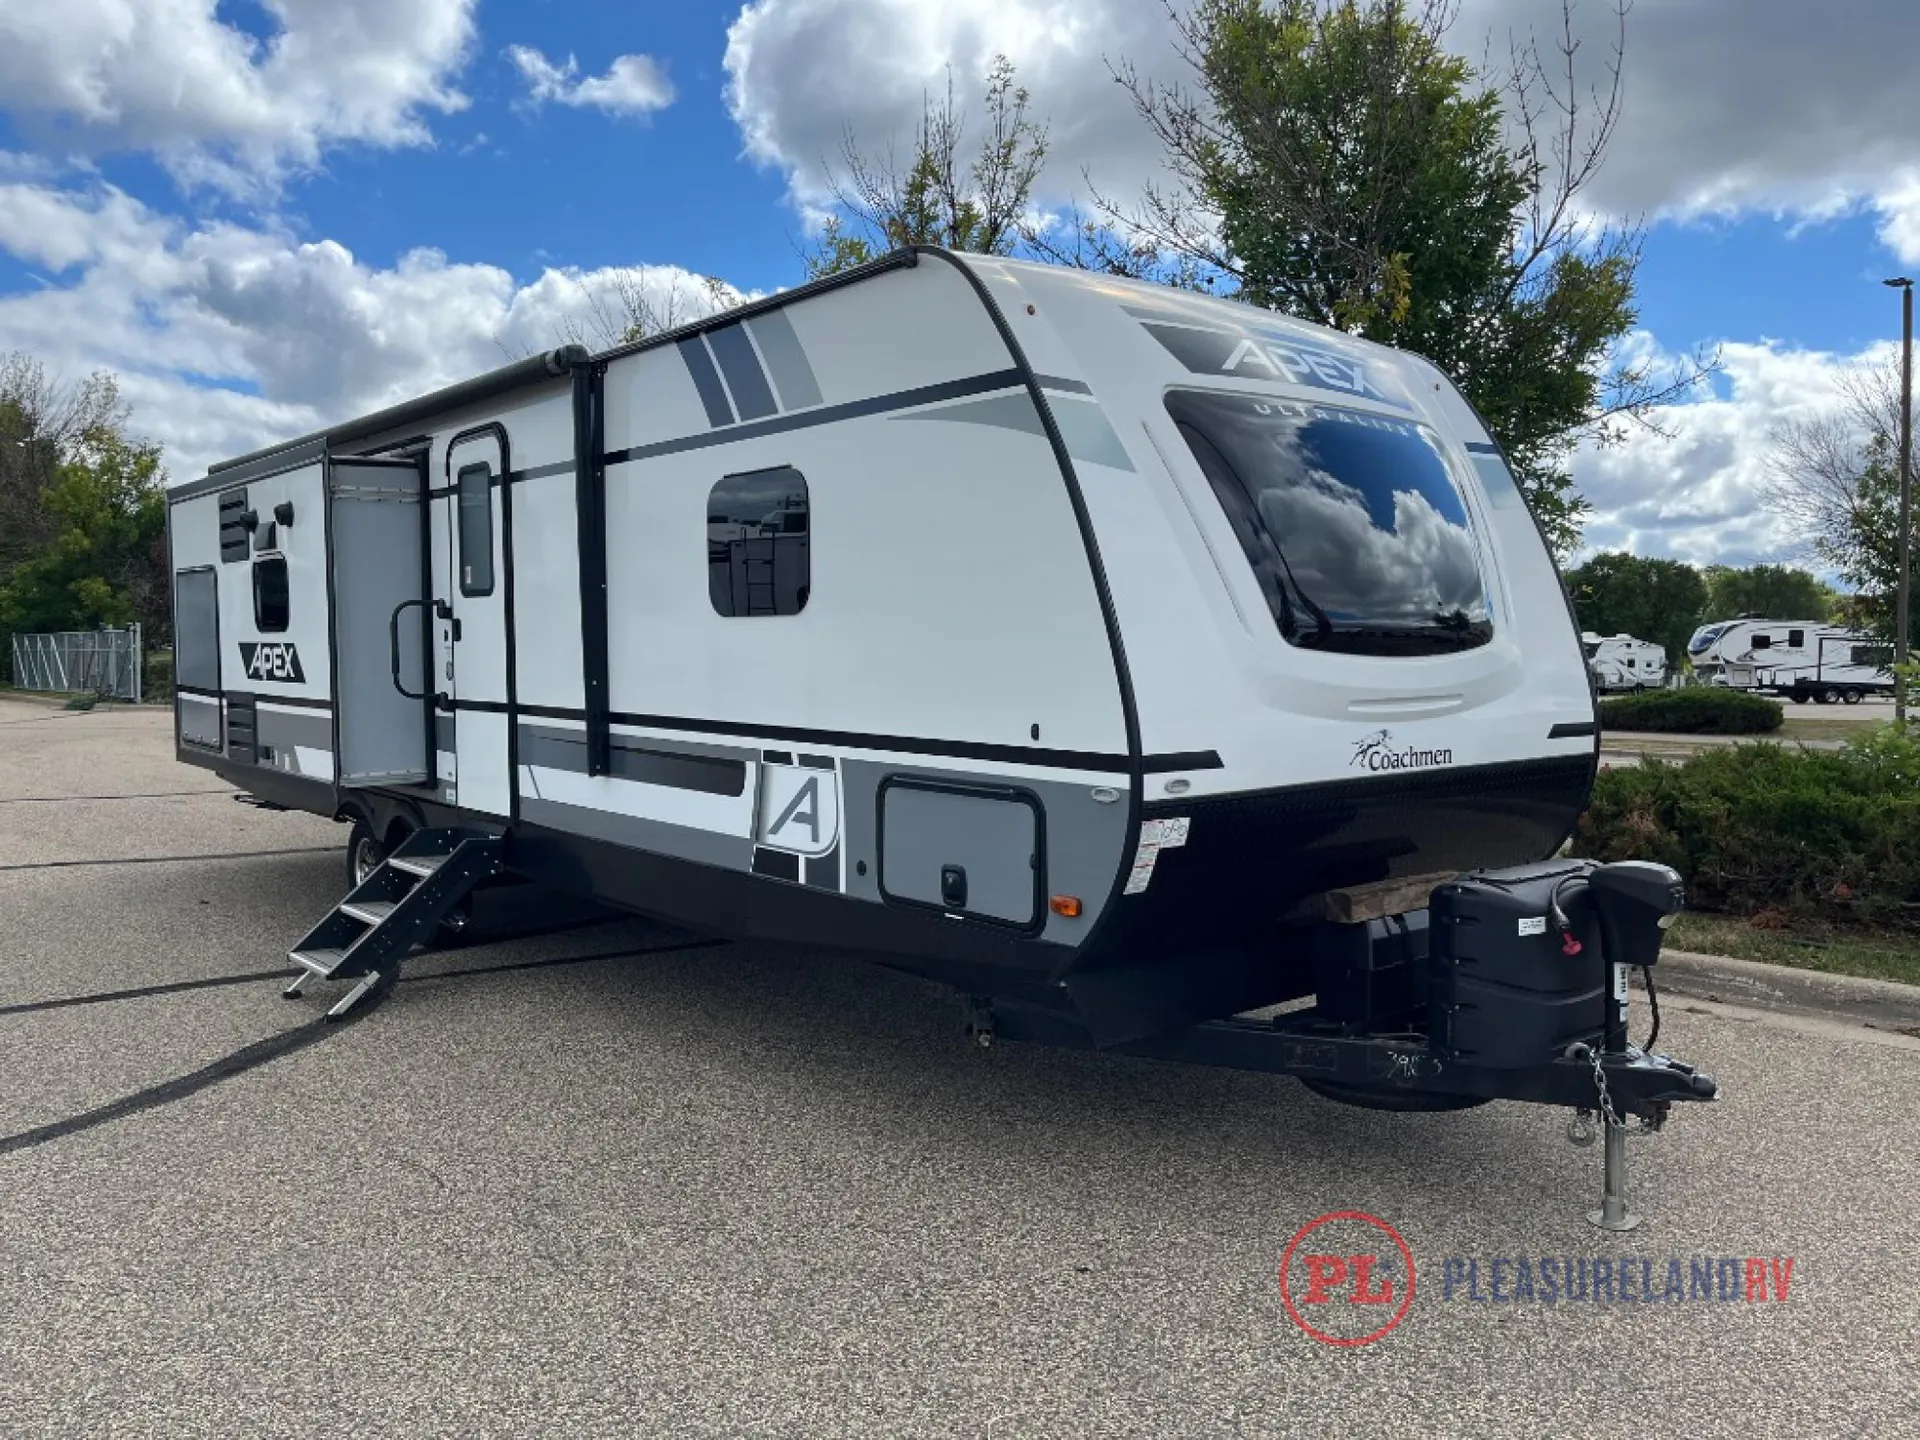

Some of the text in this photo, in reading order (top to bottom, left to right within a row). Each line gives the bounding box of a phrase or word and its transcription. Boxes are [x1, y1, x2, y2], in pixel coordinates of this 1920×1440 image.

[1221, 337, 1388, 399] APEX
[249, 642, 296, 681] APEX
[1368, 745, 1453, 771] Coachmen
[767, 775, 820, 844] A
